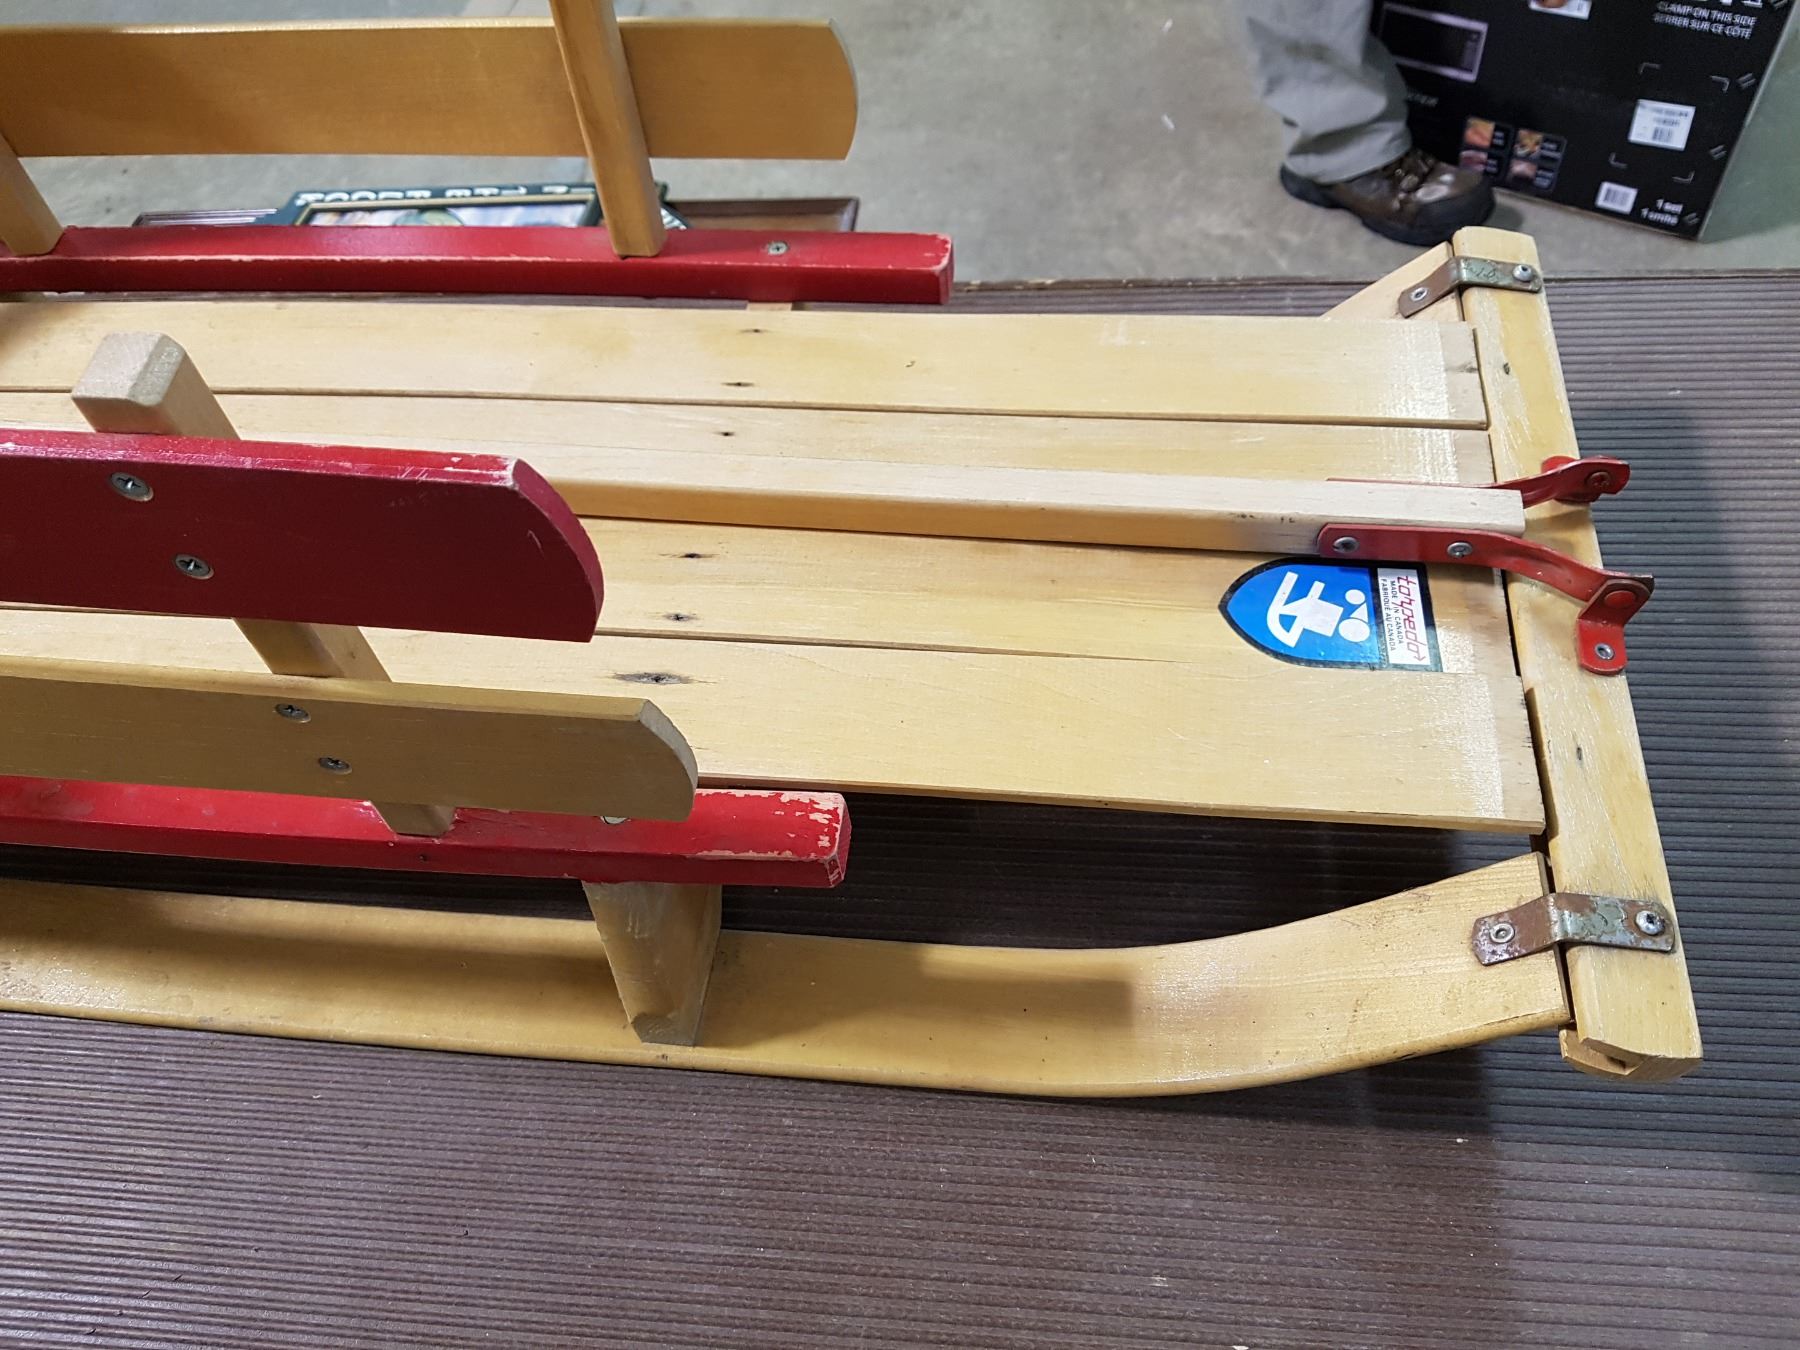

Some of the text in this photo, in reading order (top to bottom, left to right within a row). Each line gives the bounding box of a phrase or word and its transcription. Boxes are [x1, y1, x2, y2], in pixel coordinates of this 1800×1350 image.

[1385, 612, 1391, 621] AU
[1390, 580, 1398, 598] MADE
[1395, 616, 1404, 644] CANADA
[1397, 576, 1426, 661] torpedo
[1387, 623, 1396, 651] CANADA
